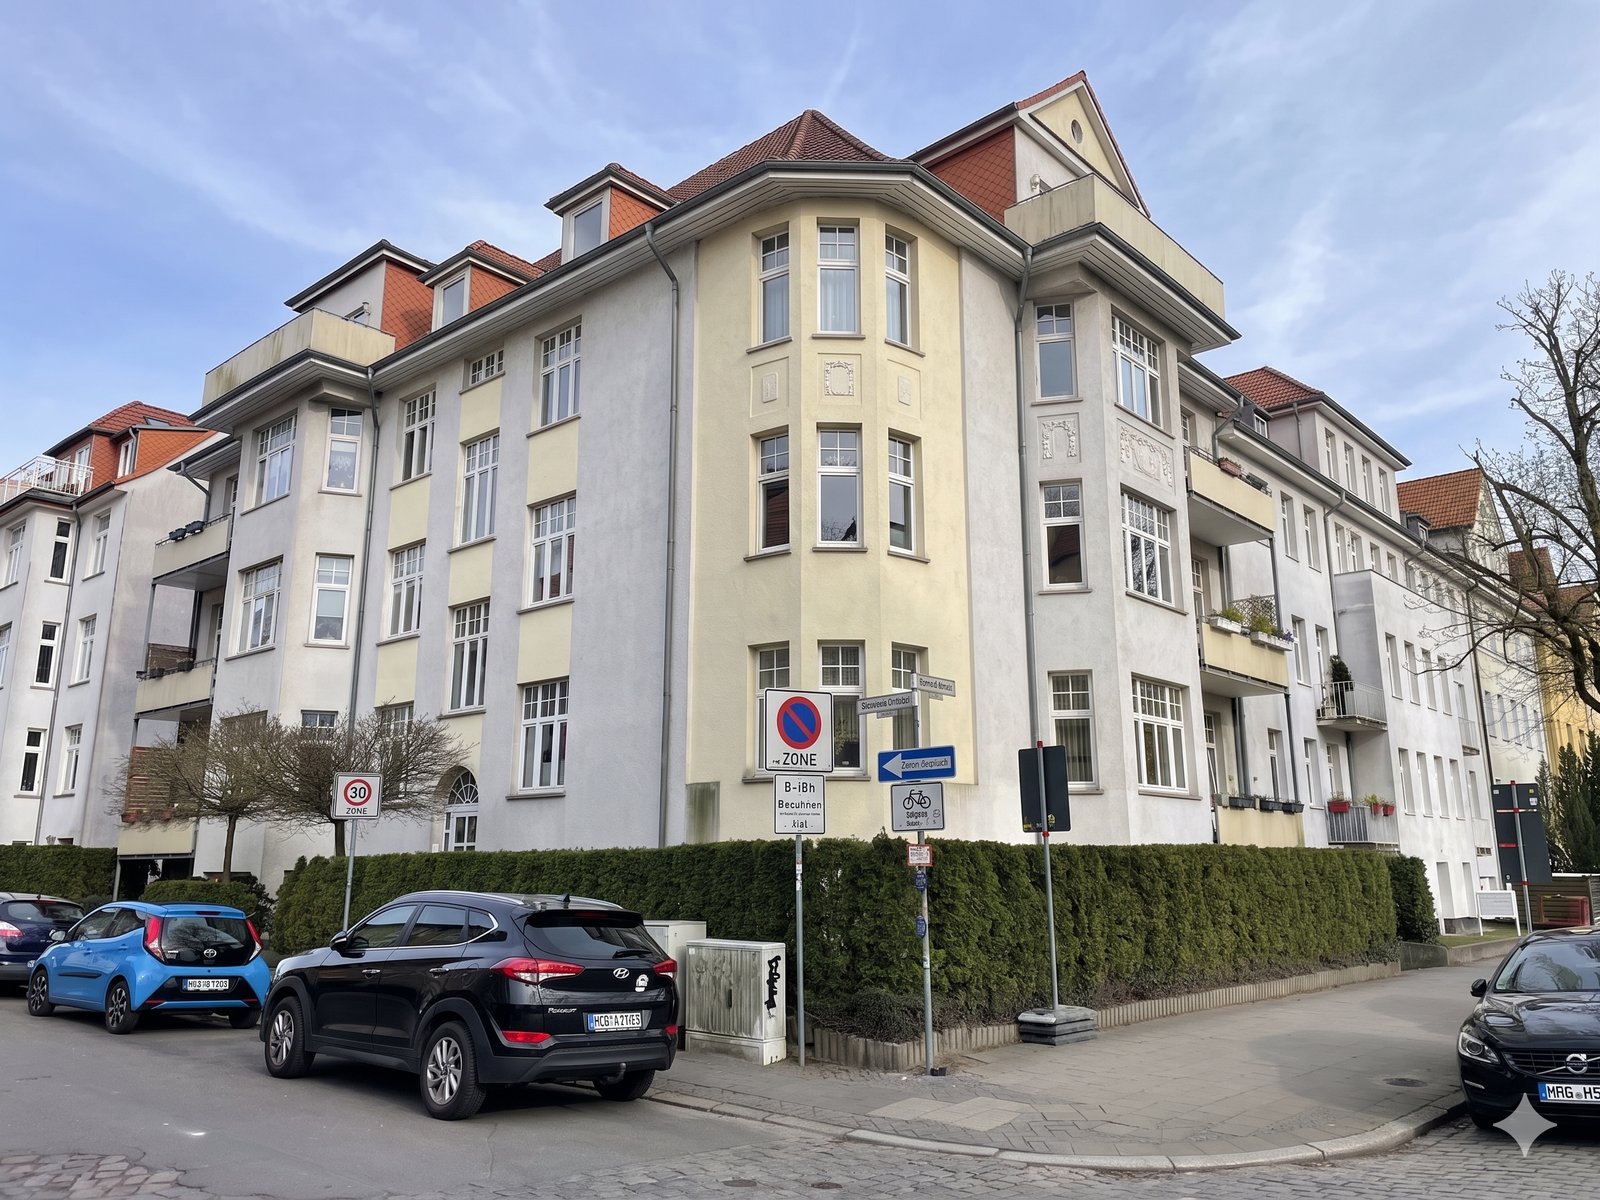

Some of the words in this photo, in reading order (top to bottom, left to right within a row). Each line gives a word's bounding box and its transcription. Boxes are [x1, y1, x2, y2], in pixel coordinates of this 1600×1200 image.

[782, 752, 817, 766] ZONE
[350, 787, 366, 799] 30
[1547, 1085, 1574, 1099] MRG
